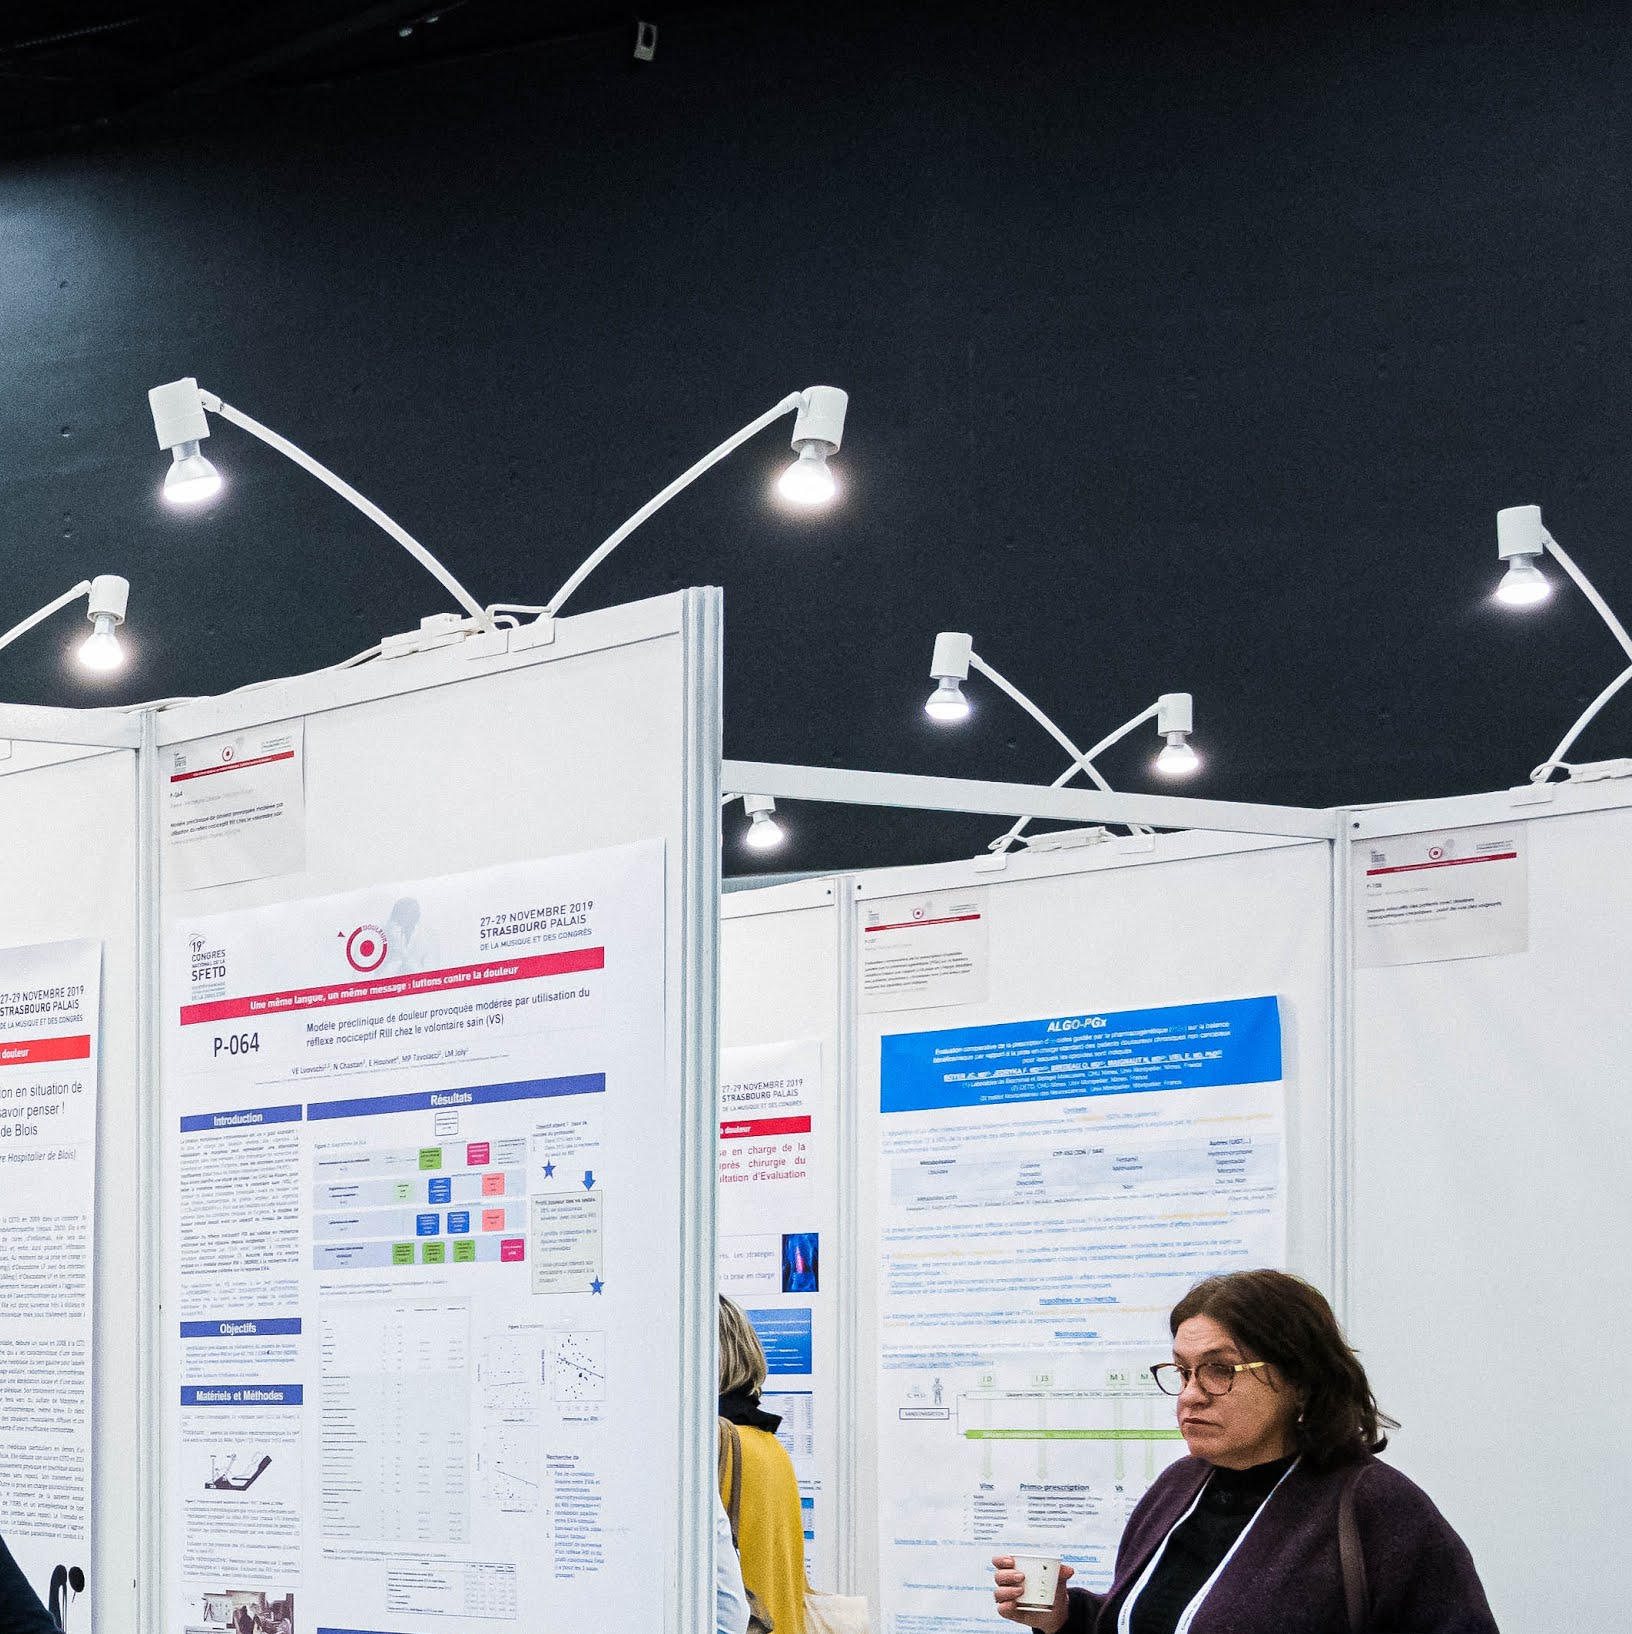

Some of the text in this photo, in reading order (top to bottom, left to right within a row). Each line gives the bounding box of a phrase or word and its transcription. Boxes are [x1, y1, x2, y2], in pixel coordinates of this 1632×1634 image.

[480, 901, 593, 926] 27-29 NOVEMBRE 2019
[480, 915, 586, 938] STRASBOURG PALAIS
[501, 938, 531, 948] MUSIQUE
[543, 934, 556, 942] DES
[192, 966, 226, 981] SFETD
[0, 986, 84, 1003] 27-29 NOVEMBRE 2019
[250, 1001, 265, 1010] Une
[268, 998, 292, 1008] même
[294, 993, 326, 1005] langue,
[341, 987, 368, 998] même
[370, 981, 406, 995] message
[413, 979, 442, 989] luttons
[444, 973, 471, 984] contre
[473, 970, 482, 980] la
[484, 965, 519, 978] douleur
[0, 1000, 79, 1016] STRASBOURG PALAIS
[387, 1014, 396, 1023] de
[399, 1005, 427, 1022] douleur
[430, 1002, 473, 1019] provoquée
[515, 996, 529, 1006] par
[532, 989, 575, 1004] utilisation
[579, 988, 590, 997] du
[337, 1029, 377, 1044] nociceptif
[395, 1026, 413, 1037] chez
[415, 1024, 422, 1034] le
[425, 1020, 464, 1033] volontaire
[467, 1017, 483, 1028] sain
[486, 1014, 504, 1027] (VS)
[1047, 1017, 1107, 1032] ALGO-PGx
[214, 1032, 259, 1057] P-064
[16, 1087, 27, 1097] en
[30, 1082, 68, 1096] situation
[72, 1081, 82, 1093] de
[722, 1079, 803, 1093] 27-29 NOVEMBRE 2019
[431, 1092, 472, 1105] Résultats
[722, 1089, 798, 1102] STRASBOURG PALAIS
[27, 1105, 59, 1118] penser
[214, 1112, 263, 1126] Introduction
[1, 1126, 12, 1137] de
[15, 1124, 37, 1136] Blois
[748, 1145, 776, 1156] charge
[782, 1144, 792, 1153] de
[798, 1142, 805, 1152] la
[749, 1158, 786, 1169] chirurgie
[795, 1156, 805, 1165] du
[753, 1170, 805, 1182] d'Evaluation
[220, 1322, 256, 1335] Objectifs
[196, 1390, 283, 1401] Matériels et Méthodes
[1020, 1483, 1089, 1492] Primo-prescription
